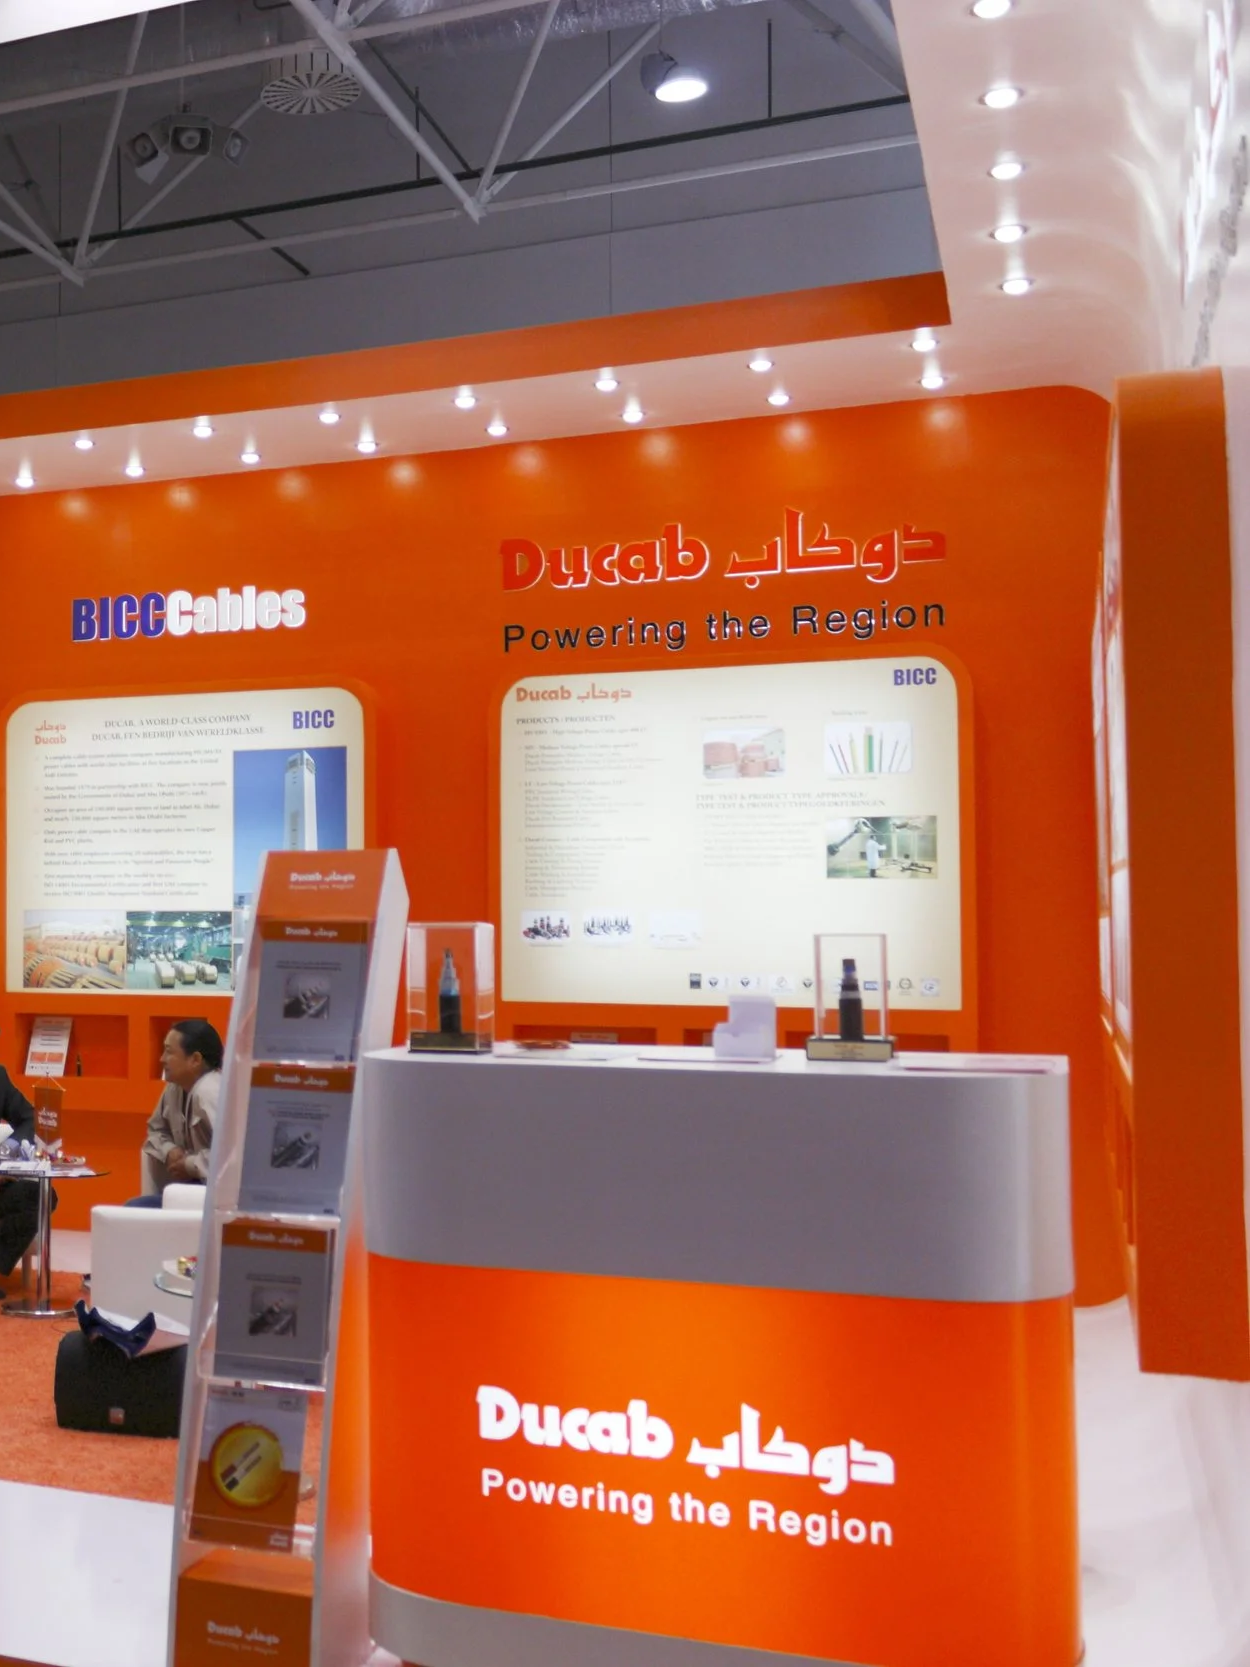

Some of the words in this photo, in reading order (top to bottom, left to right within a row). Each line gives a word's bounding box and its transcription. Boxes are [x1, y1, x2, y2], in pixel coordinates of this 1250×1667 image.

[499, 522, 710, 591] Ducab
[724, 505, 947, 589] دوكاب
[503, 616, 687, 653] Powering
[706, 610, 771, 641] the
[791, 600, 947, 640] Region
[515, 684, 572, 702] Ducab
[893, 667, 937, 686] BICC
[34, 733, 67, 746] Ducab
[292, 709, 335, 730] BICC
[475, 1384, 675, 1460] Ducab
[686, 1402, 895, 1495] دوكاب
[481, 1467, 654, 1525] Powering
[669, 1491, 731, 1528] the
[748, 1499, 893, 1548] Region
